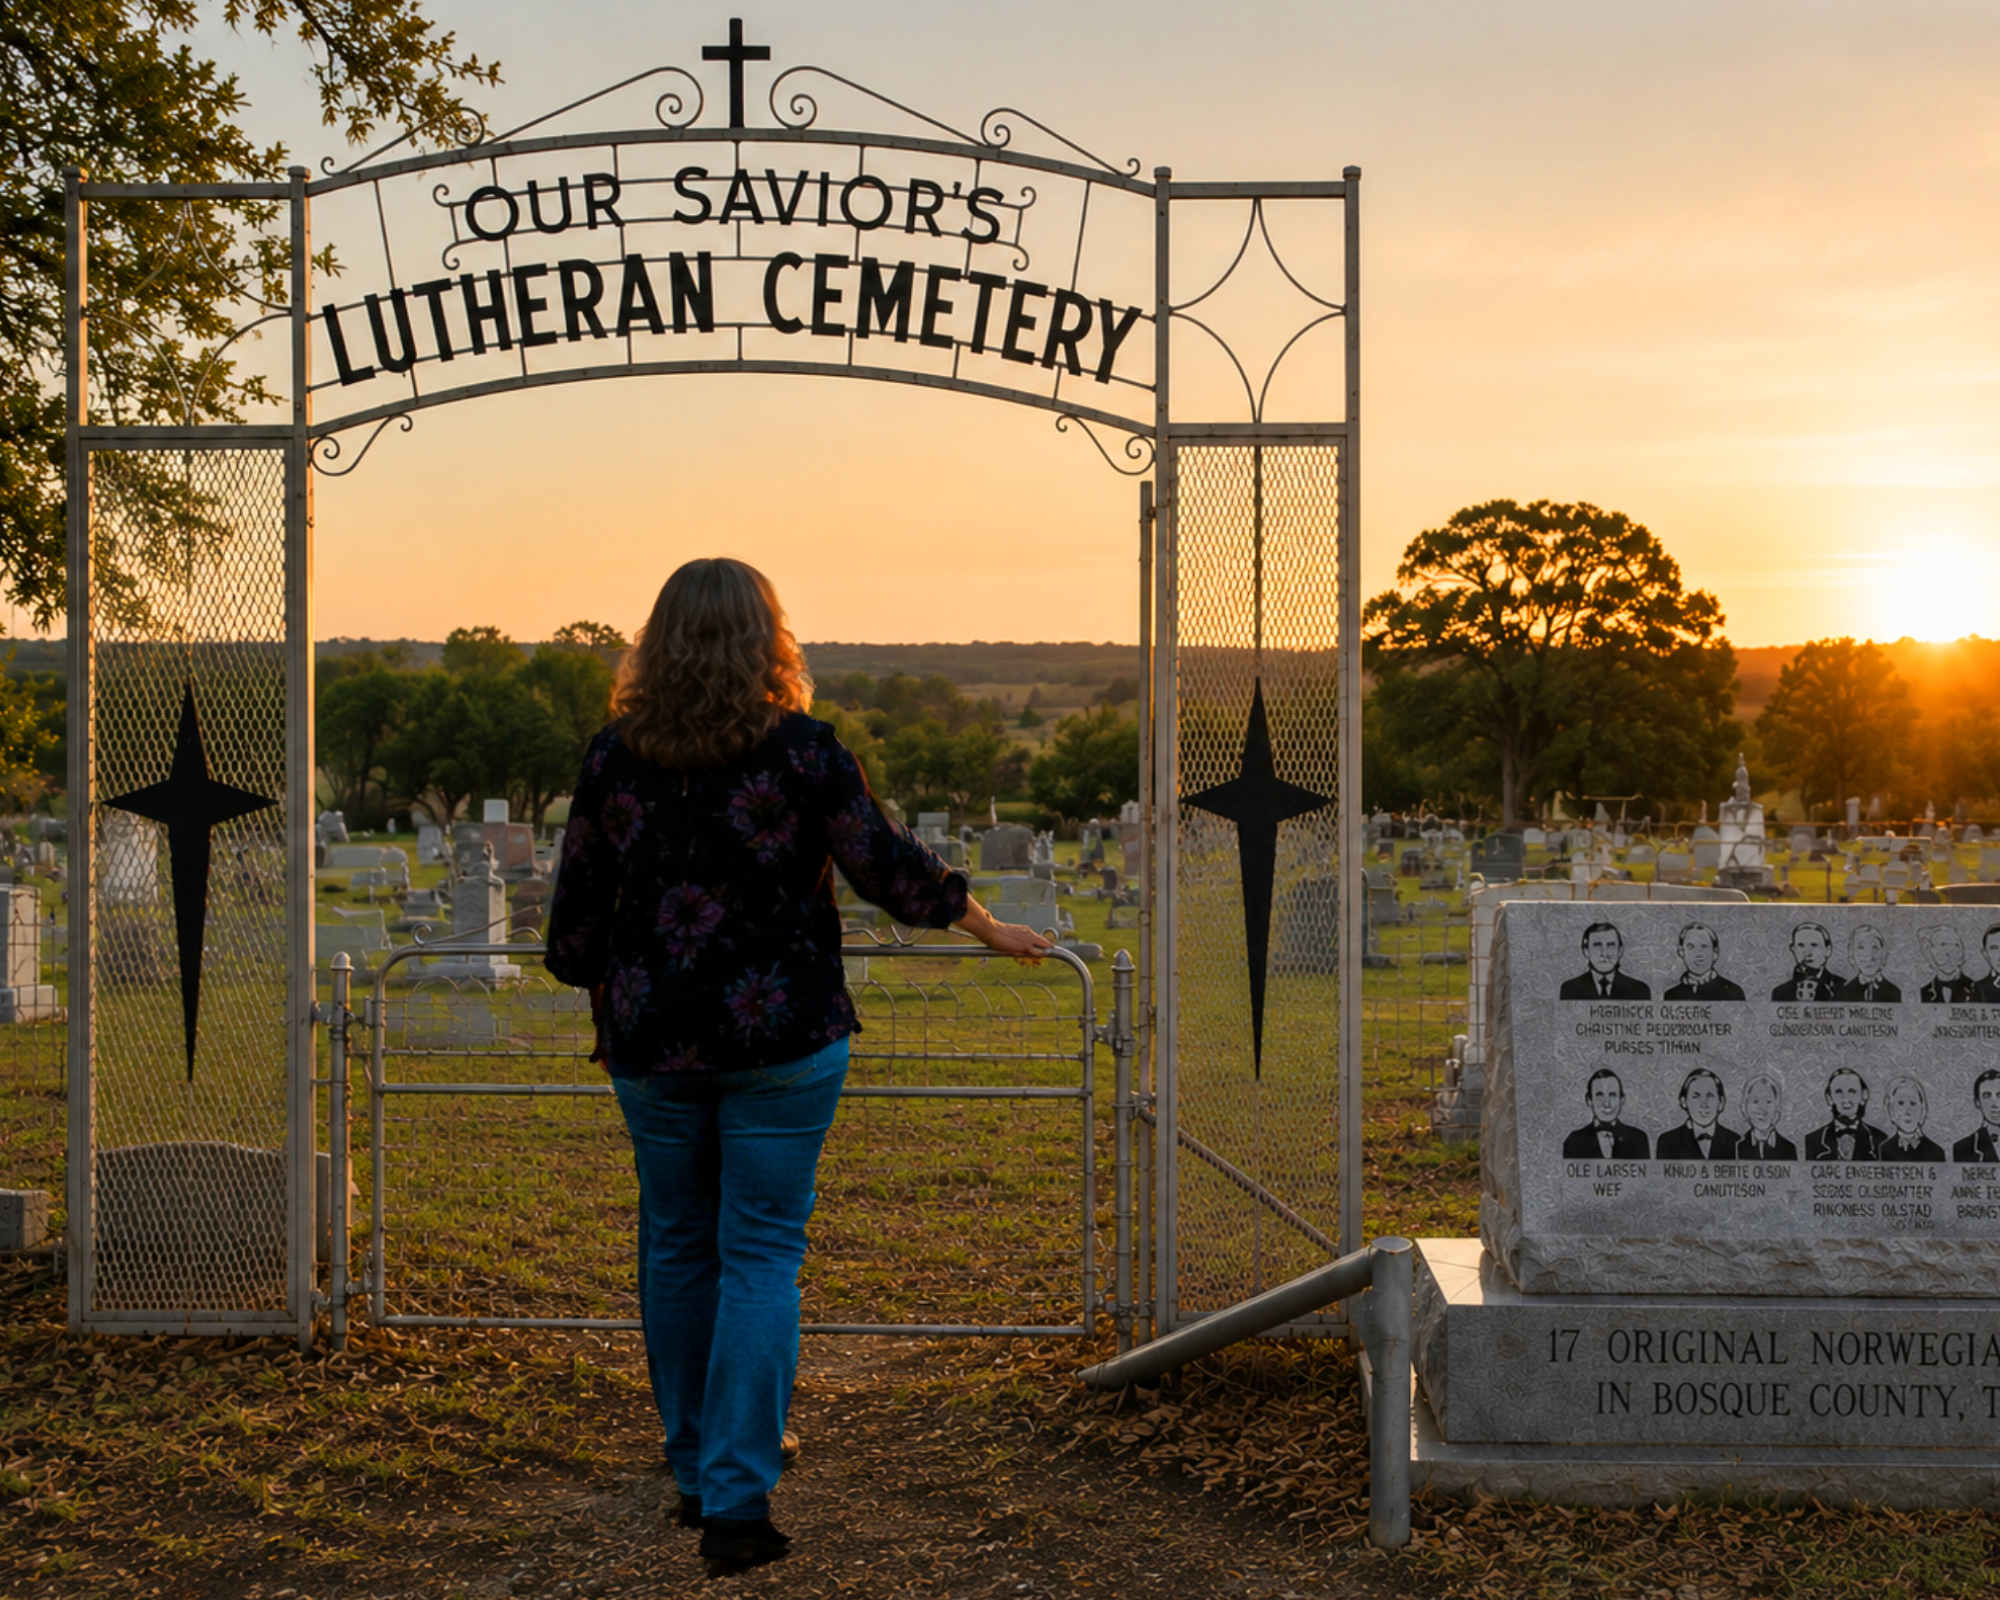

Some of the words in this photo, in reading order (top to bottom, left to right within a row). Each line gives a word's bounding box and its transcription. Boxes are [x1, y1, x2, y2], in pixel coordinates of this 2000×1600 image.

[464, 173, 626, 241] OUR
[673, 166, 1005, 243] SAVIOR'S
[322, 251, 713, 386] LUTHERAN
[763, 251, 1143, 384] CEMETERY
[1566, 1163, 1591, 1178] OLE
[1596, 1163, 1647, 1178] LARSEN
[1593, 1182, 1623, 1197] WEF
[1548, 1328, 1581, 1363] 17
[1606, 1329, 1789, 1365] ORIGINAL
[1811, 1331, 2000, 1366] NORWEGIA
[1596, 1381, 1632, 1415] IN
[1652, 1382, 1791, 1419] BOSQUE
[1809, 1383, 1965, 1422] COUNTY,
